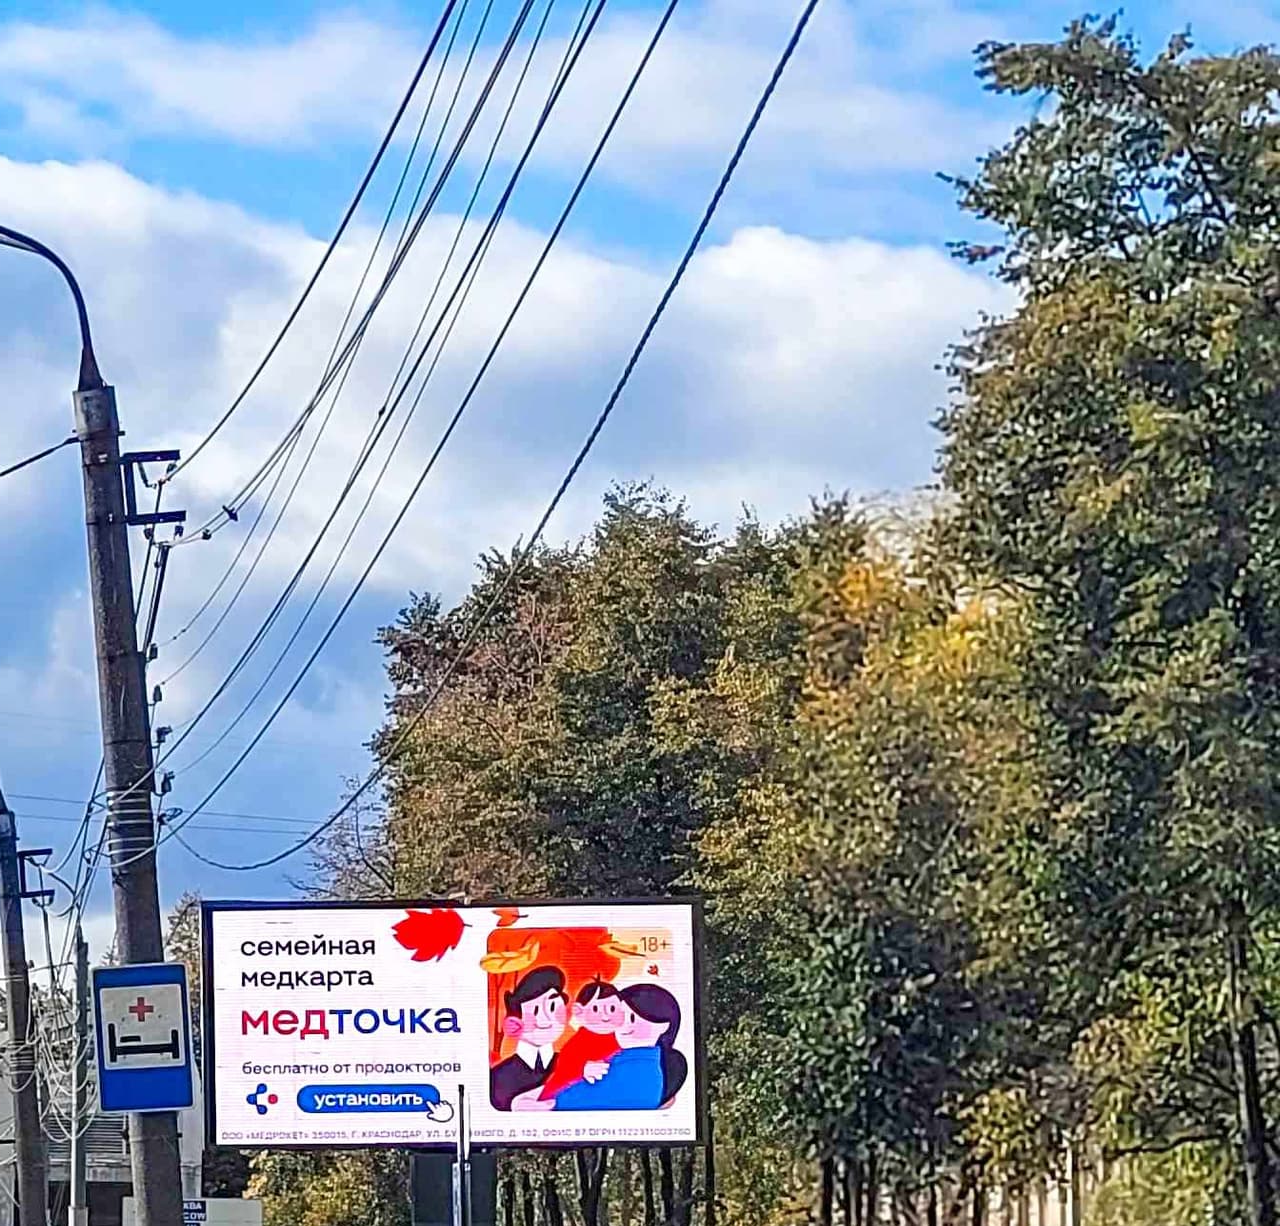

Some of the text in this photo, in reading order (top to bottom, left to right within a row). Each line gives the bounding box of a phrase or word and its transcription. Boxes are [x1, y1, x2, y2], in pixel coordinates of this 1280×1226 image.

[240, 934, 376, 956] семейная
[640, 936, 671, 952] 18+
[241, 969, 374, 992] медкарта
[241, 1007, 461, 1040] медточка
[242, 1061, 462, 1076] бесплатно от продокторов
[314, 1092, 423, 1109] установить
[184, 1212, 206, 1220] COW
